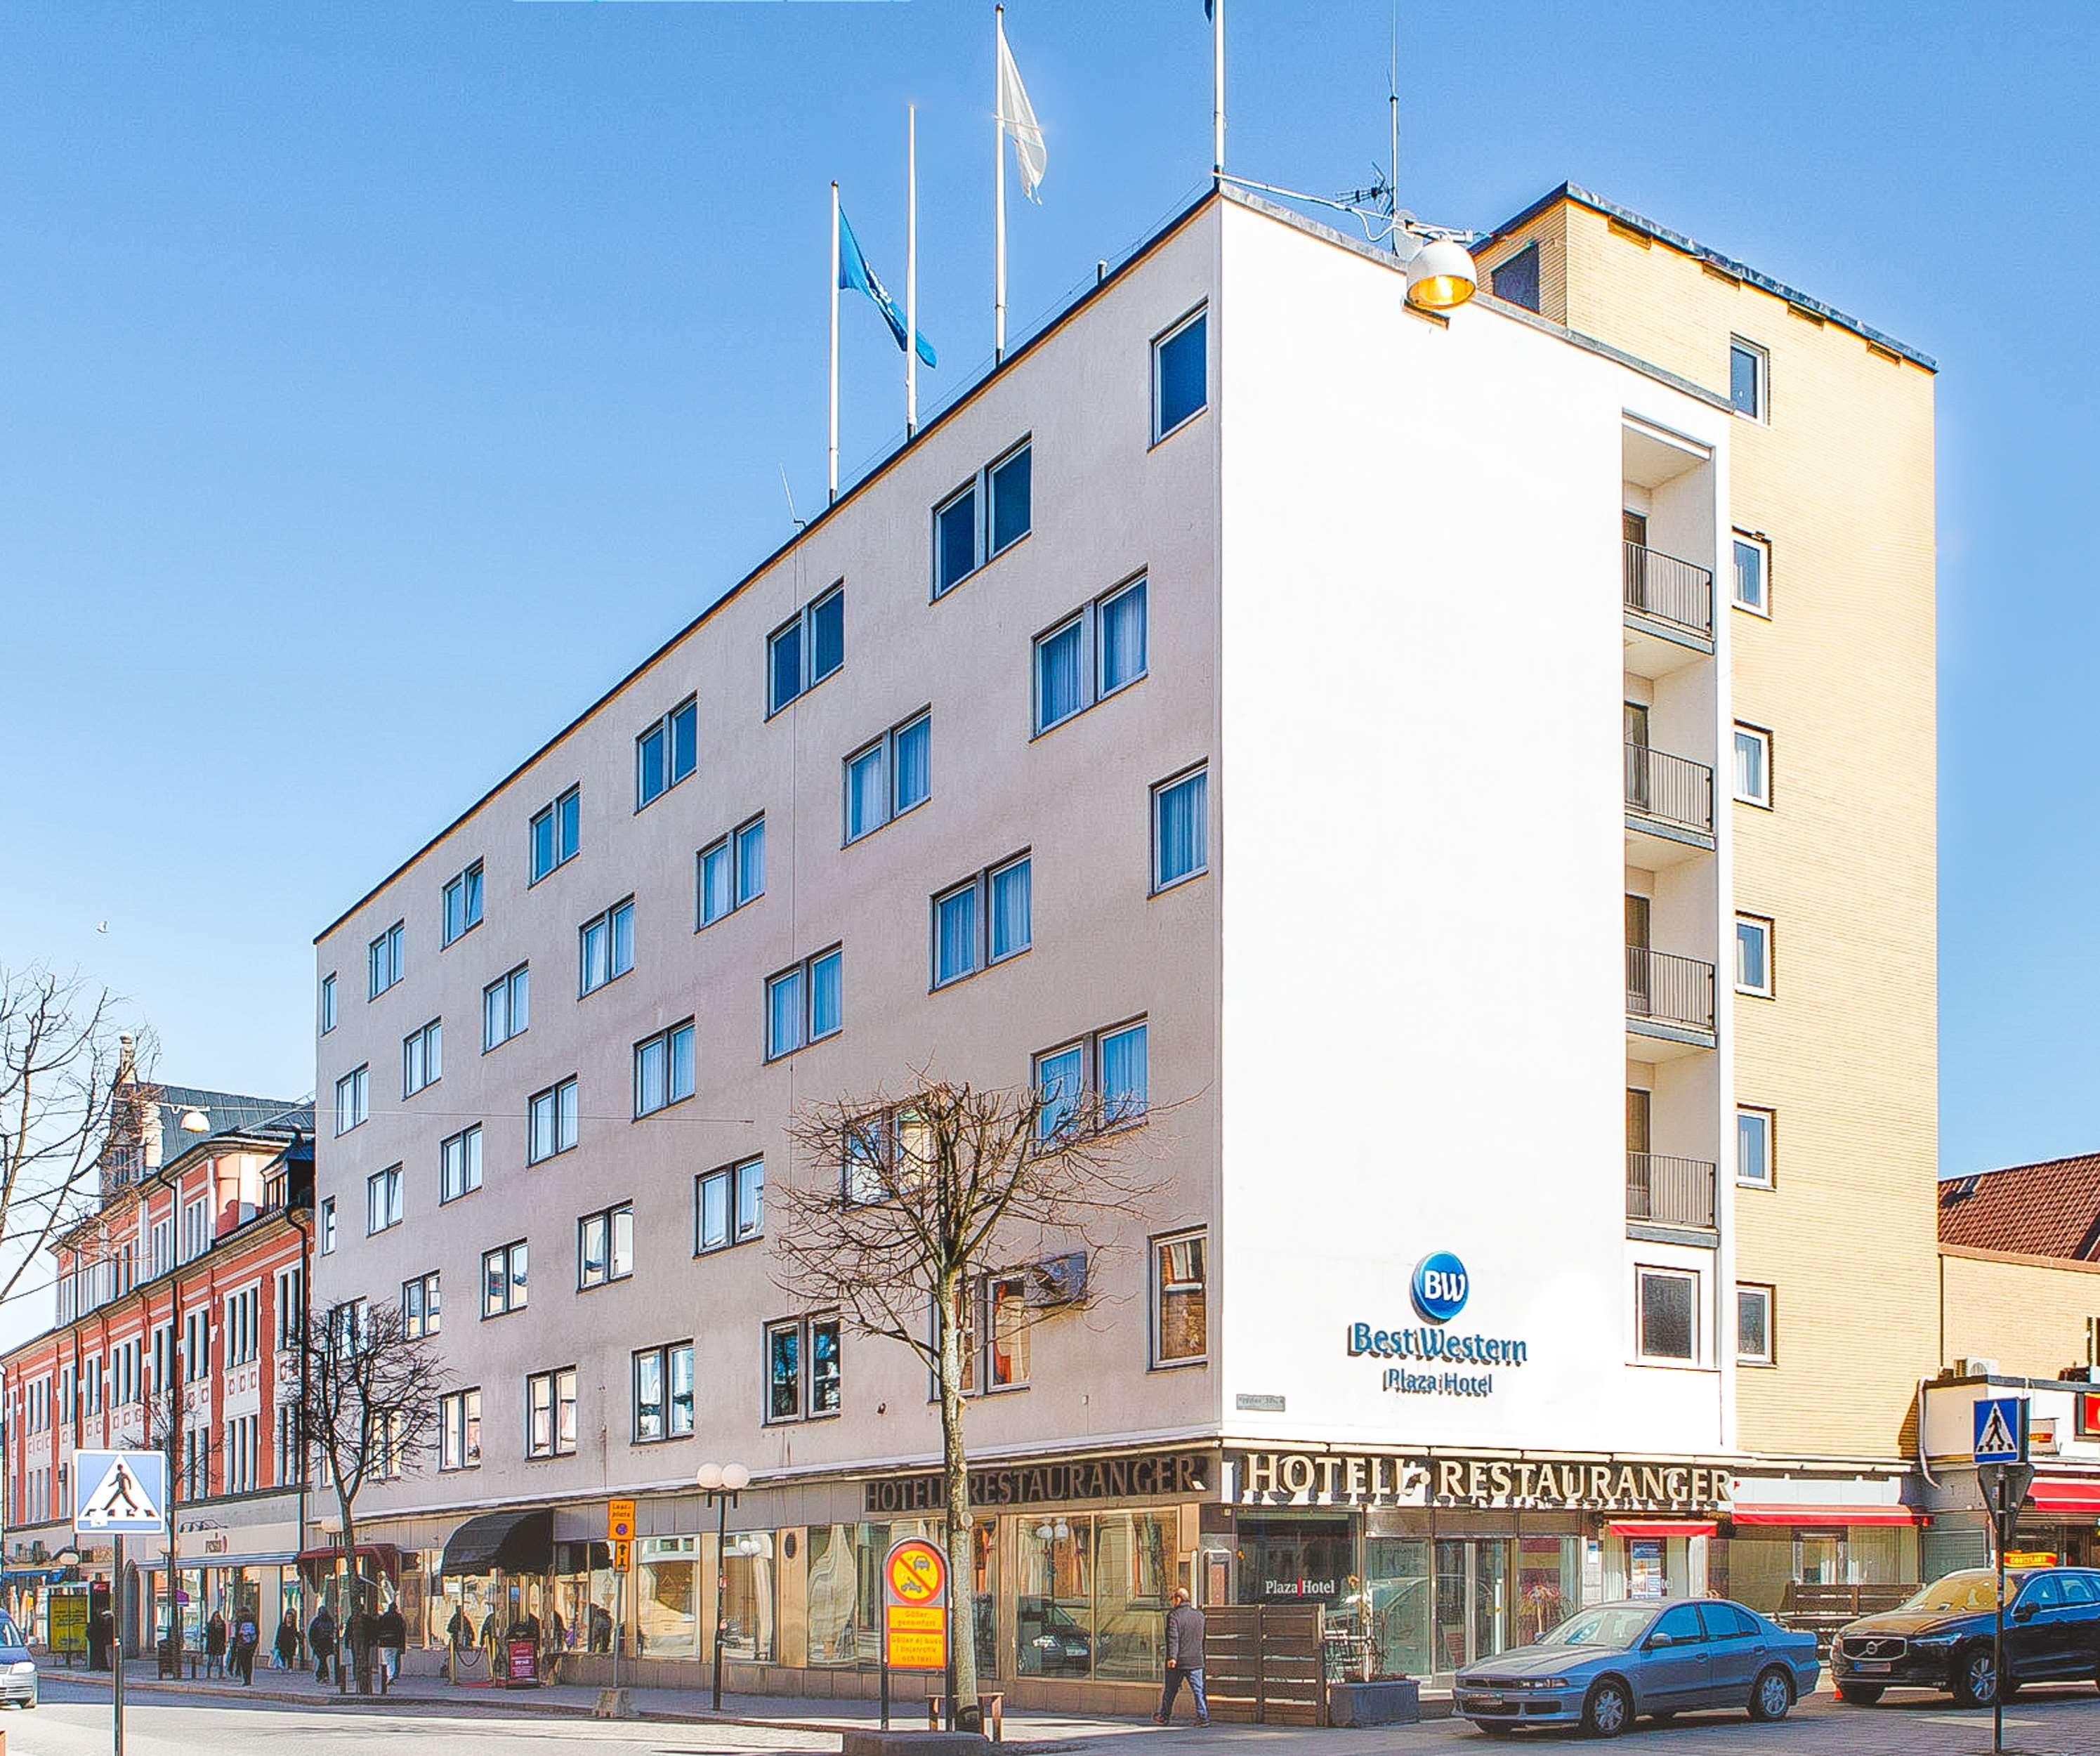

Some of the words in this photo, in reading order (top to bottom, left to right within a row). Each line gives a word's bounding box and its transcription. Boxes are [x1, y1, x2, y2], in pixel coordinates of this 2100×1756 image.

[1424, 1270, 1466, 1302] BW
[1353, 1322, 1415, 1355] Best
[1419, 1327, 1528, 1361] Western
[1388, 1368, 1436, 1391] Plaza
[1444, 1372, 1492, 1394] Hotel
[967, 1457, 1207, 1505] RESTAURANGER
[1246, 1453, 1415, 1495] HOTELL
[1438, 1460, 1731, 1502] RESTAURANGER
[1265, 1580, 1298, 1594] Plaza
[1302, 1580, 1335, 1594] Hotel
